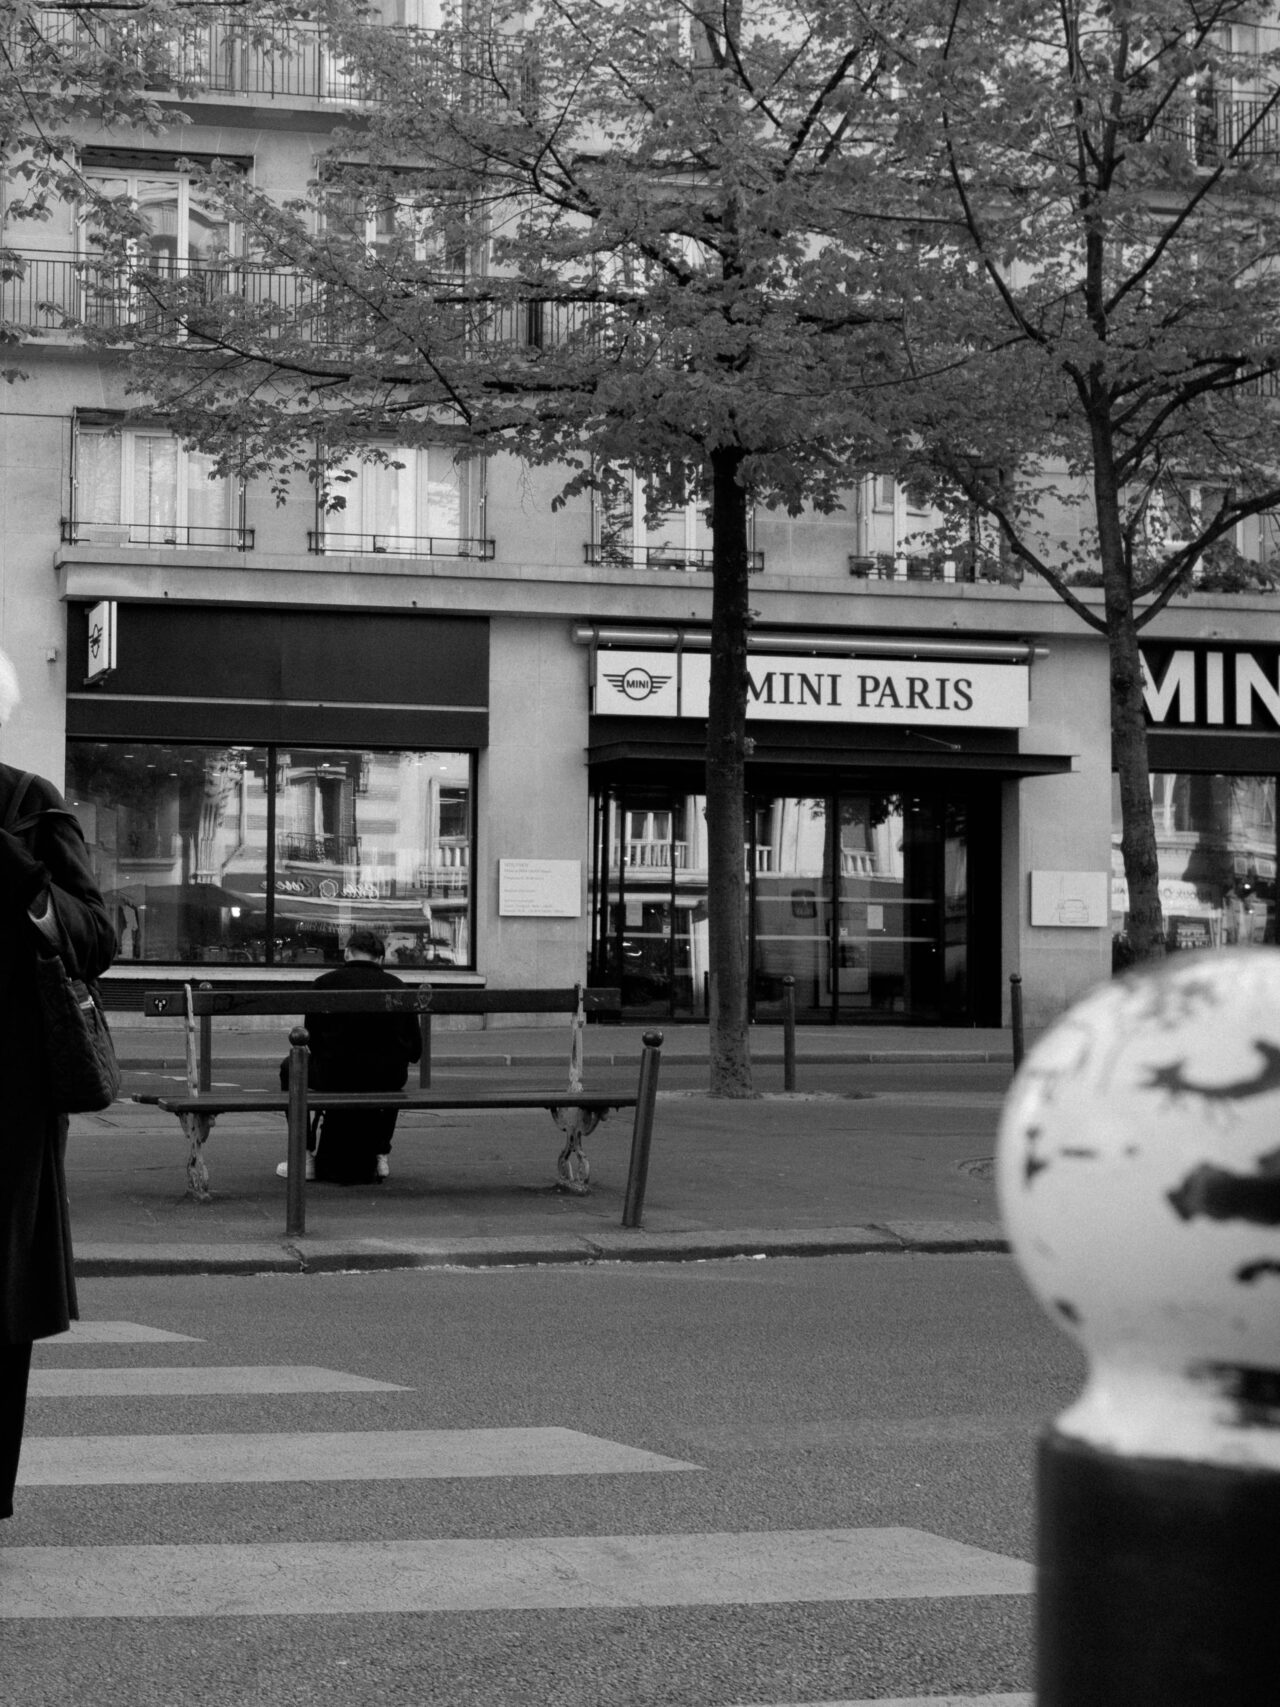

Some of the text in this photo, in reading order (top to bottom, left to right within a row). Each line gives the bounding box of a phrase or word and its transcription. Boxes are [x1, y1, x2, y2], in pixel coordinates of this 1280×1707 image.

[626, 679, 649, 689] MINI
[747, 671, 974, 711] MINI PARIS
